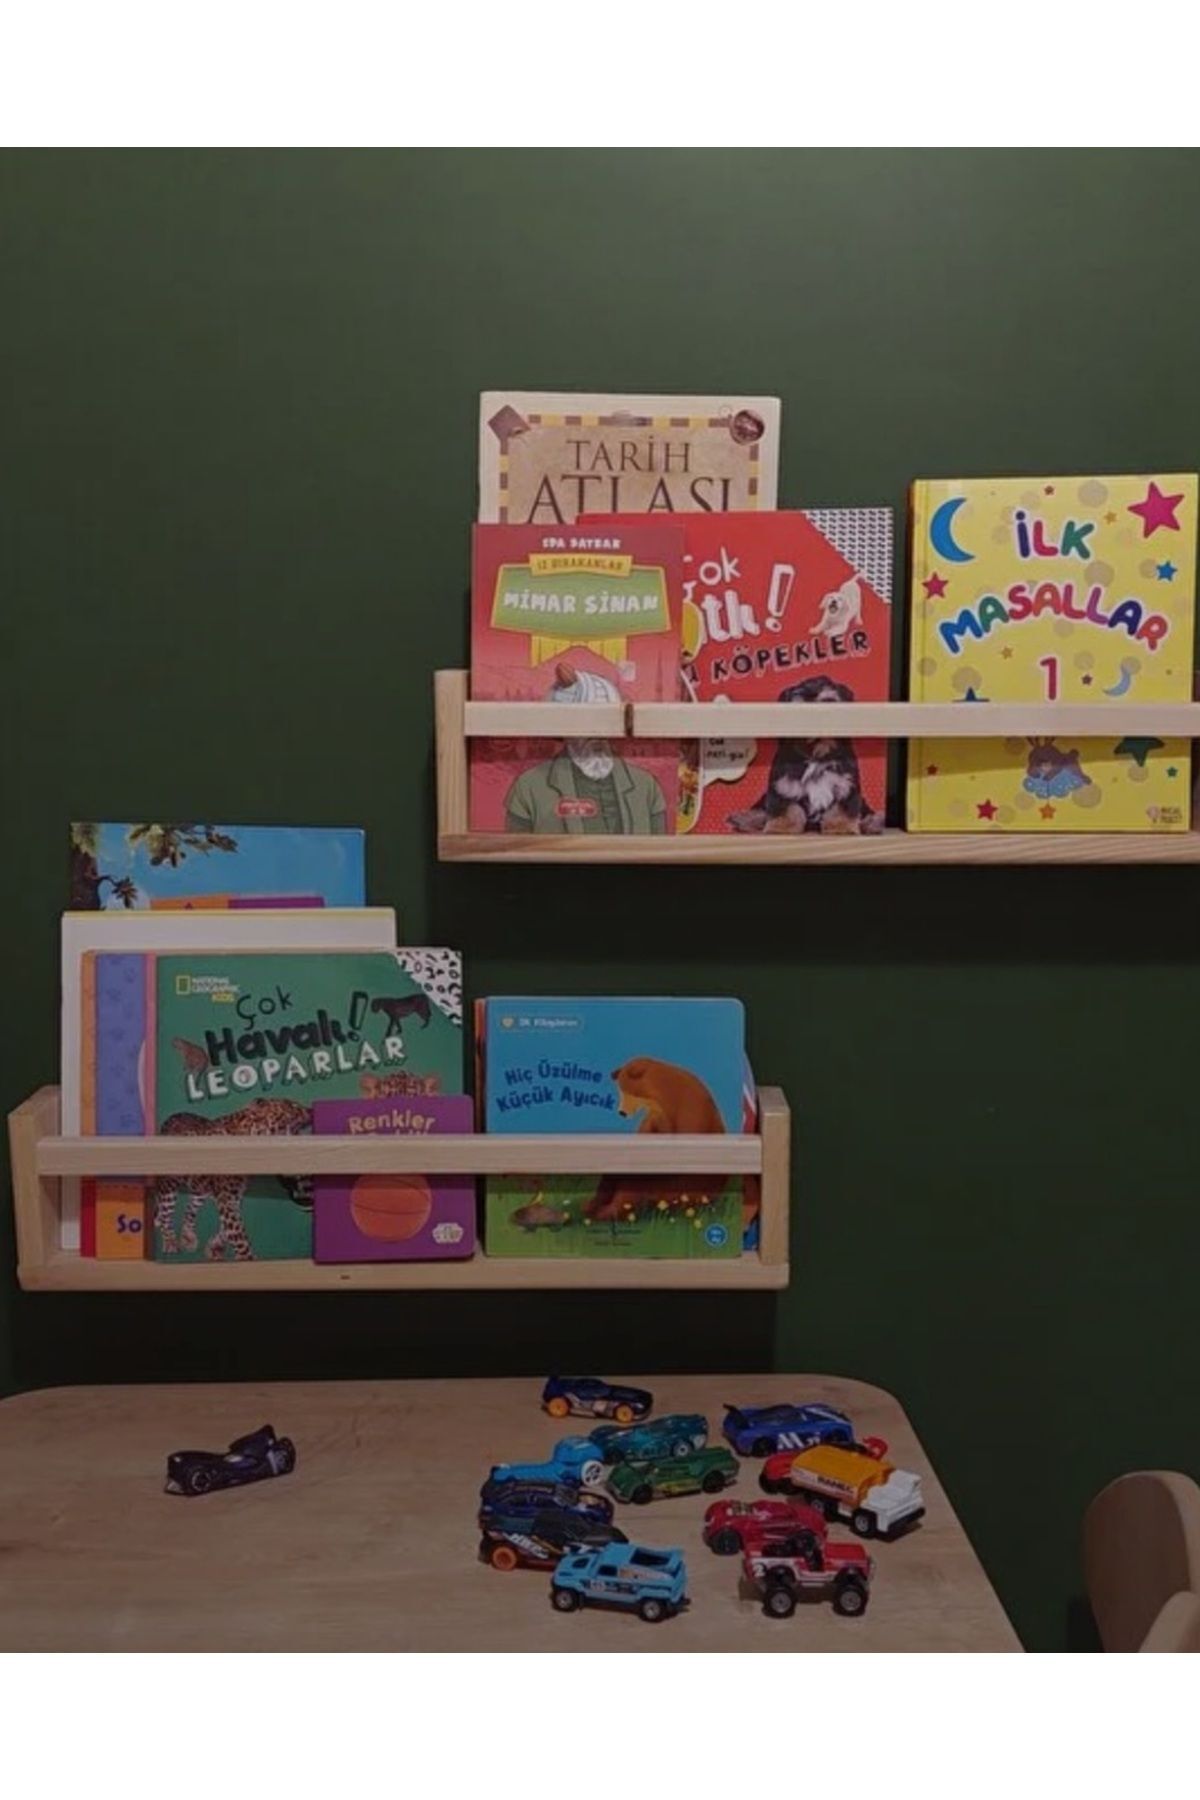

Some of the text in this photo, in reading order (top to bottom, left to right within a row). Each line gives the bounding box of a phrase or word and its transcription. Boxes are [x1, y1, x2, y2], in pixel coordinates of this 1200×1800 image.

[566, 435, 690, 473] TARİH
[1015, 510, 1095, 559] İLK
[503, 589, 659, 615] MİMAR SİNAN
[939, 582, 1168, 654] MASALLAR
[712, 631, 872, 682] KÖPEKLER
[1039, 656, 1057, 700] 1
[204, 991, 368, 1066] Havalı!
[236, 986, 293, 1030] Çok
[186, 1035, 405, 1100] LEOPARLAR
[505, 1059, 602, 1086] Hiç Üzülme
[348, 1109, 436, 1134] Renkler
[496, 1086, 616, 1113] Küçük Ayıcık
